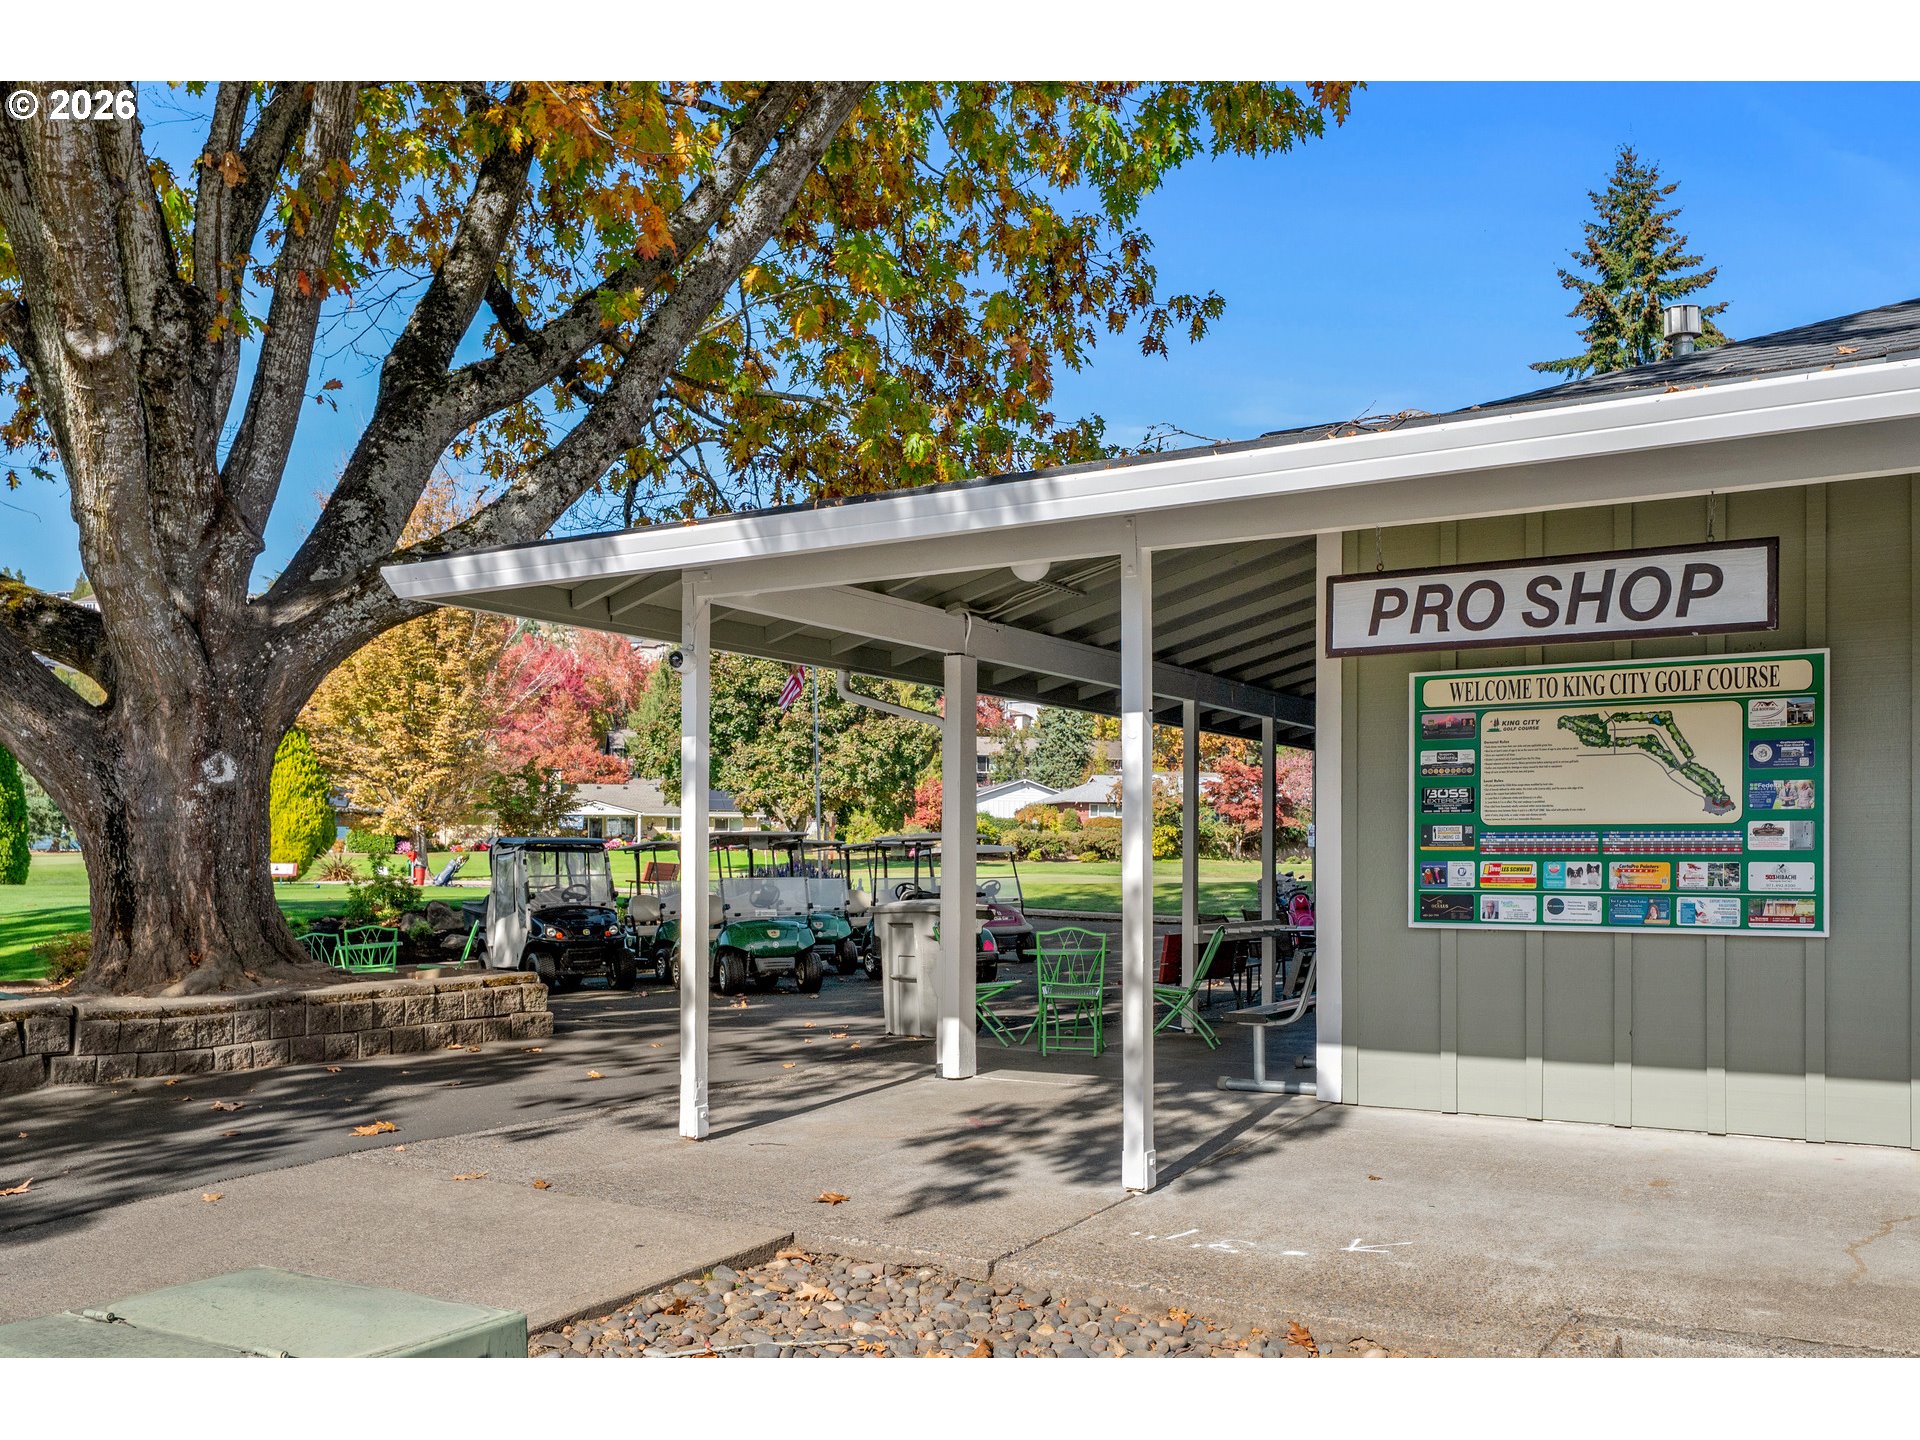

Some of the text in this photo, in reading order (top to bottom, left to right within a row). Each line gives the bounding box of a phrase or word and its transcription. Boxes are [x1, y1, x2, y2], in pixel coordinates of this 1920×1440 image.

[1368, 562, 1724, 637] PRO SHOP
[1449, 664, 1781, 703] WELCOME TO KING CITY GOLF COURSE
[1501, 718, 1541, 727] KING CITY
[1426, 788, 1469, 799] BOSS
